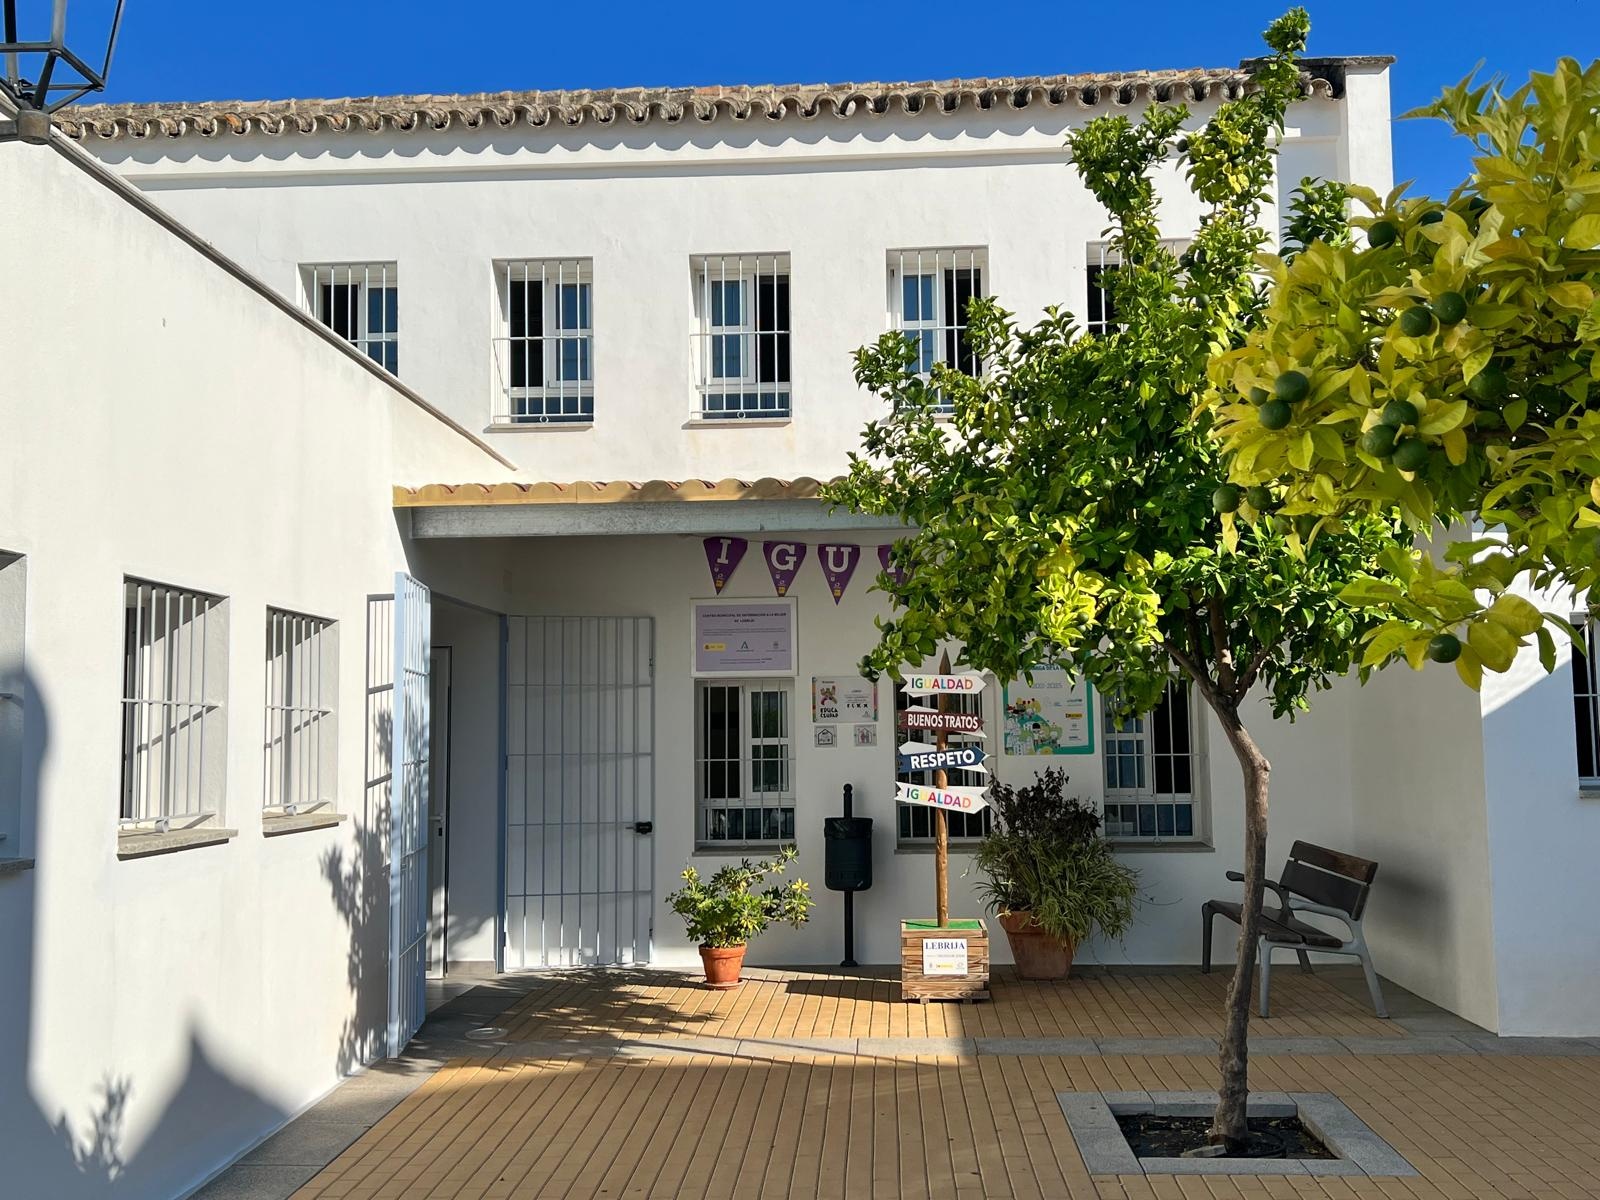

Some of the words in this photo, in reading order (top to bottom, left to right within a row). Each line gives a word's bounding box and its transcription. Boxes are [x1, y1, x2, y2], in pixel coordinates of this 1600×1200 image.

[911, 677, 973, 690] IGUALDAD
[907, 713, 943, 728] BUENOS
[944, 715, 979, 730] TRATOS
[910, 749, 975, 769] RESPETO
[906, 787, 972, 808] IGUALDAD
[925, 941, 965, 950] LEBRIJA
